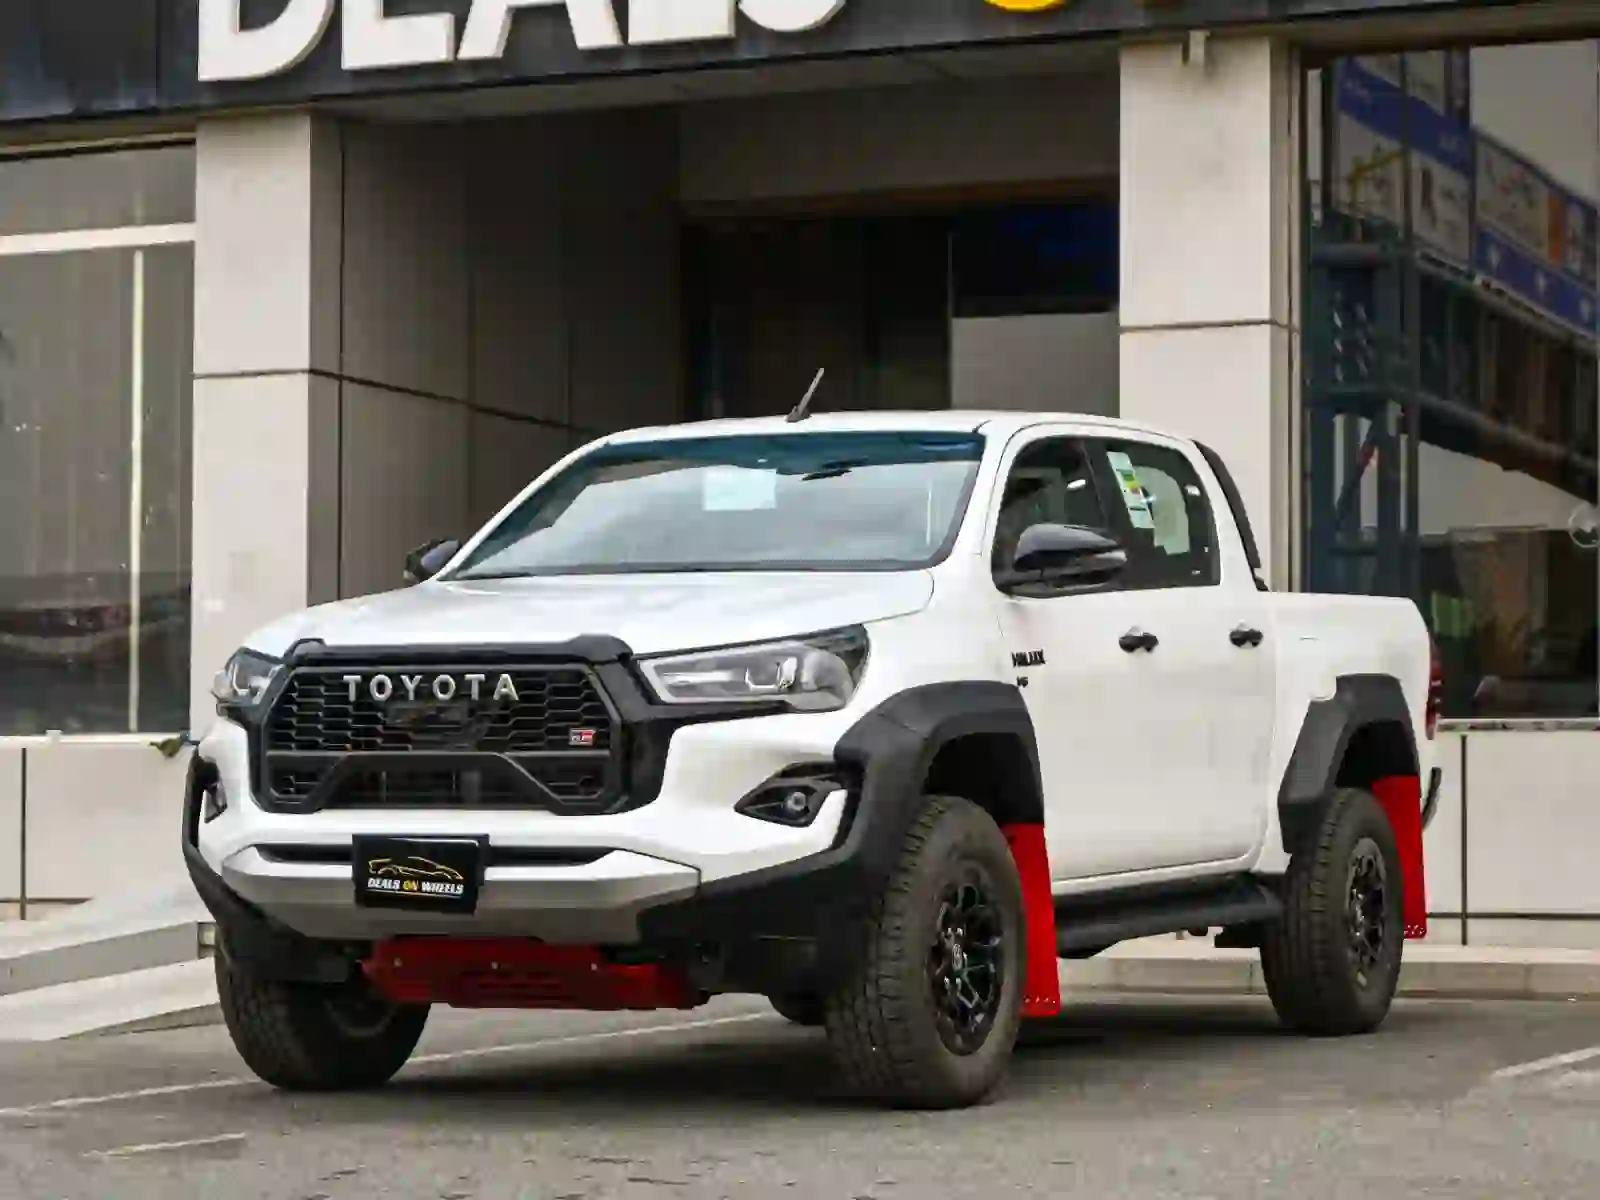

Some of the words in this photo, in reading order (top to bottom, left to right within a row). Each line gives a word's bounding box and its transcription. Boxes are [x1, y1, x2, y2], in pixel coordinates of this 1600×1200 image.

[342, 673, 519, 702] TOYOTA
[367, 878, 401, 890] DEALS
[402, 879, 420, 892] ON
[421, 881, 464, 894] WHEELS
